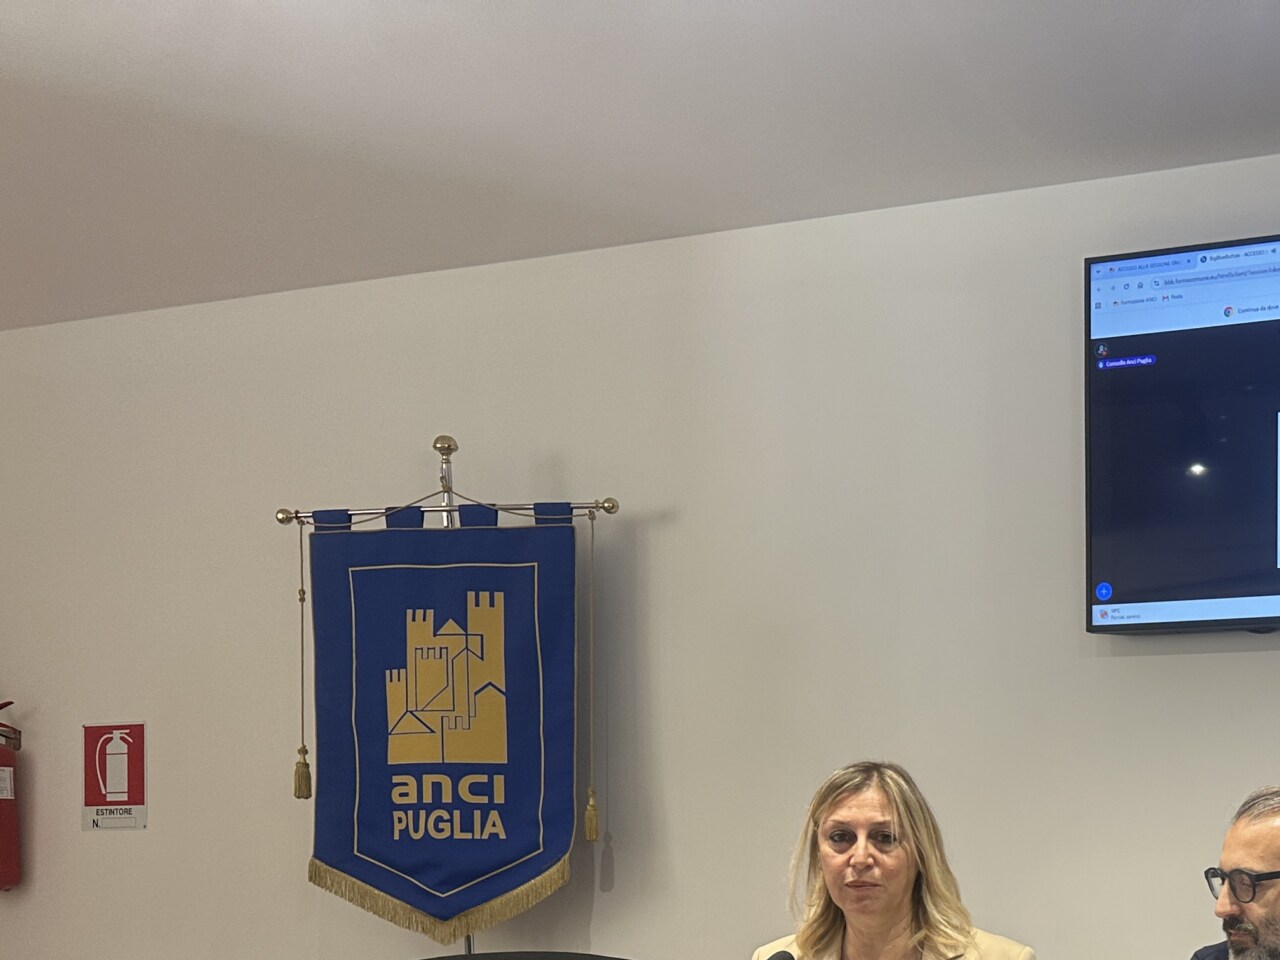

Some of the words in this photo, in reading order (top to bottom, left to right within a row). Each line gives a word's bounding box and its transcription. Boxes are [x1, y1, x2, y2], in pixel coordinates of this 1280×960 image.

[391, 774, 505, 804] anci
[96, 808, 132, 816] ESTINTORE
[392, 809, 506, 840] PUGLIA
